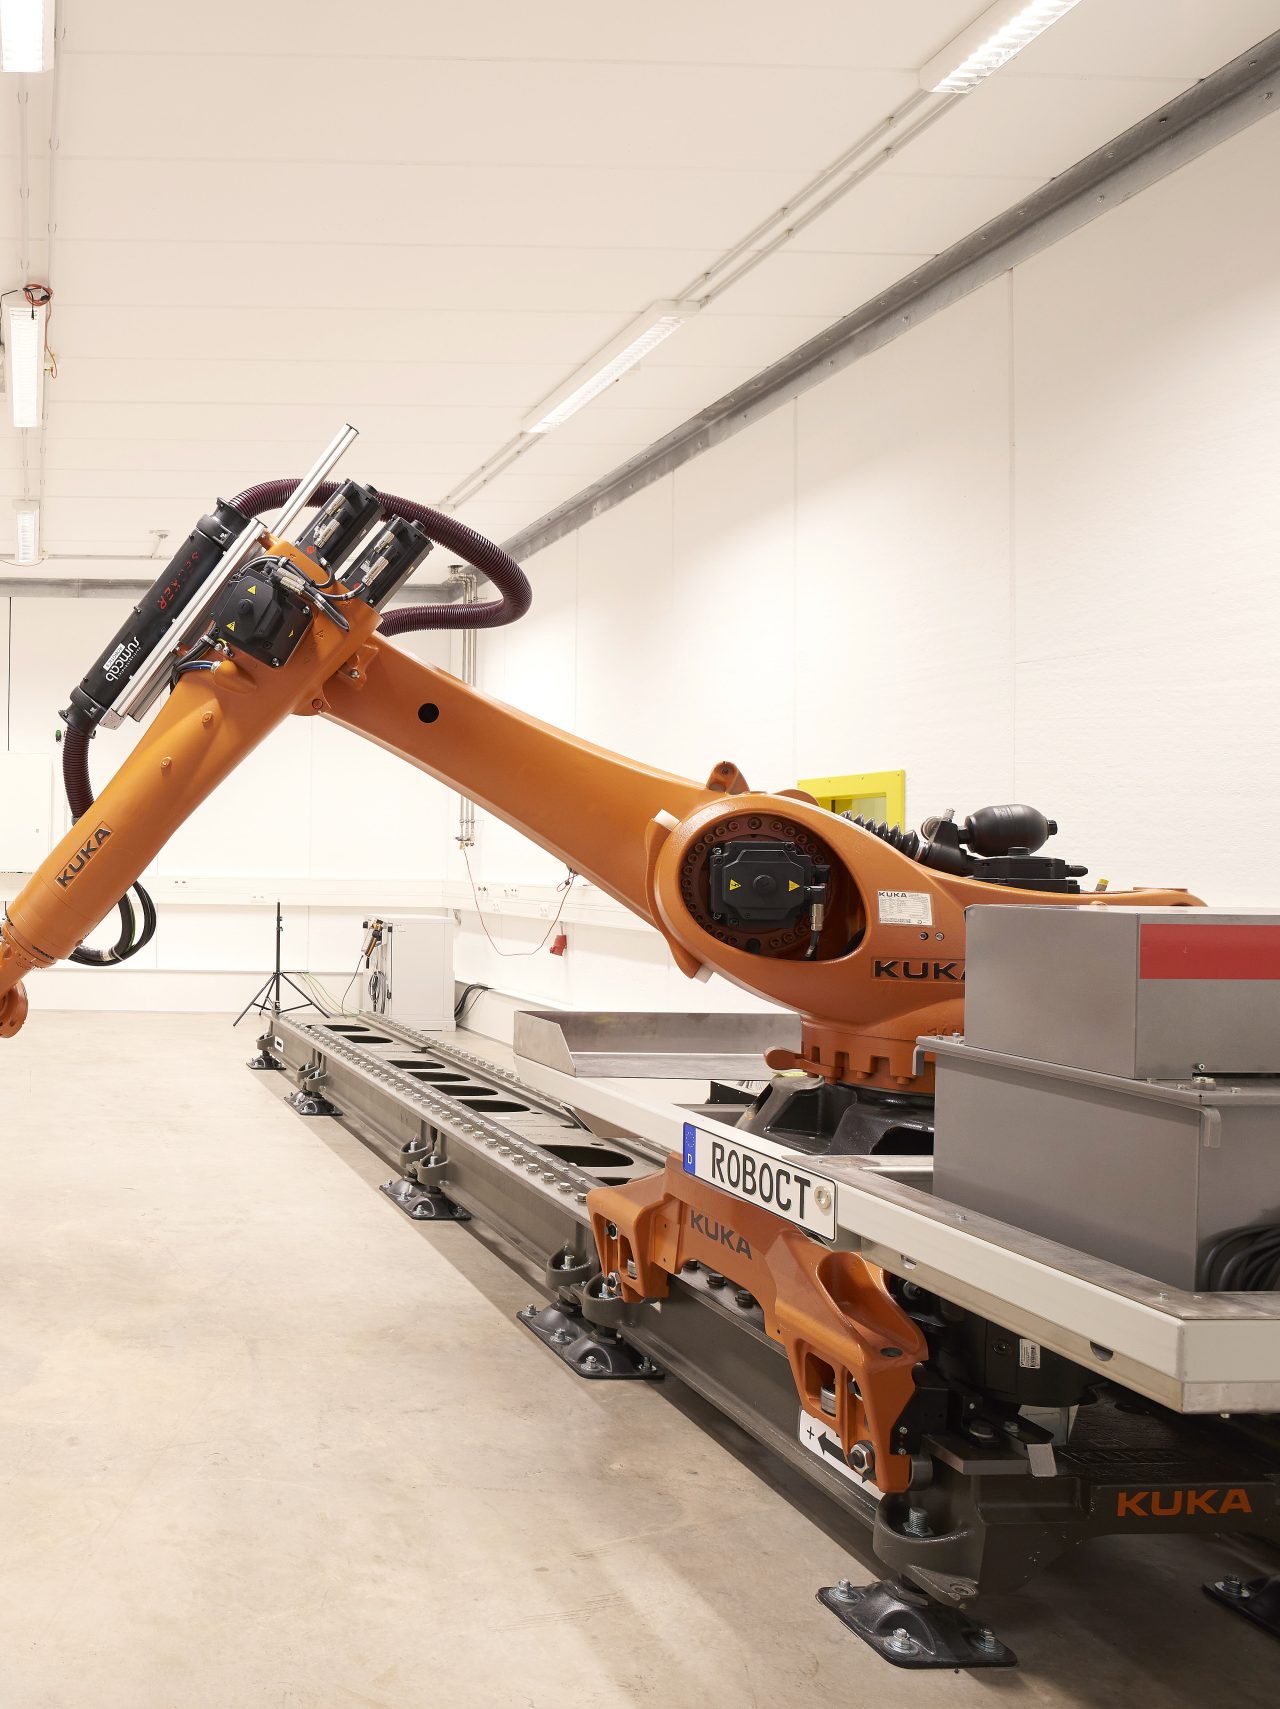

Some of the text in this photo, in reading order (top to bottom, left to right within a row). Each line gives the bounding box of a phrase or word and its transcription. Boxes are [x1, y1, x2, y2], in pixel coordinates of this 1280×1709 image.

[105, 636, 140, 682] sumcab
[56, 828, 111, 888] KUKA
[878, 891, 908, 899] KUKA
[687, 1153, 693, 1165] D
[711, 1141, 811, 1220] ROBOCT
[690, 1209, 753, 1261] KUKA
[1117, 1488, 1253, 1517] KUKA
